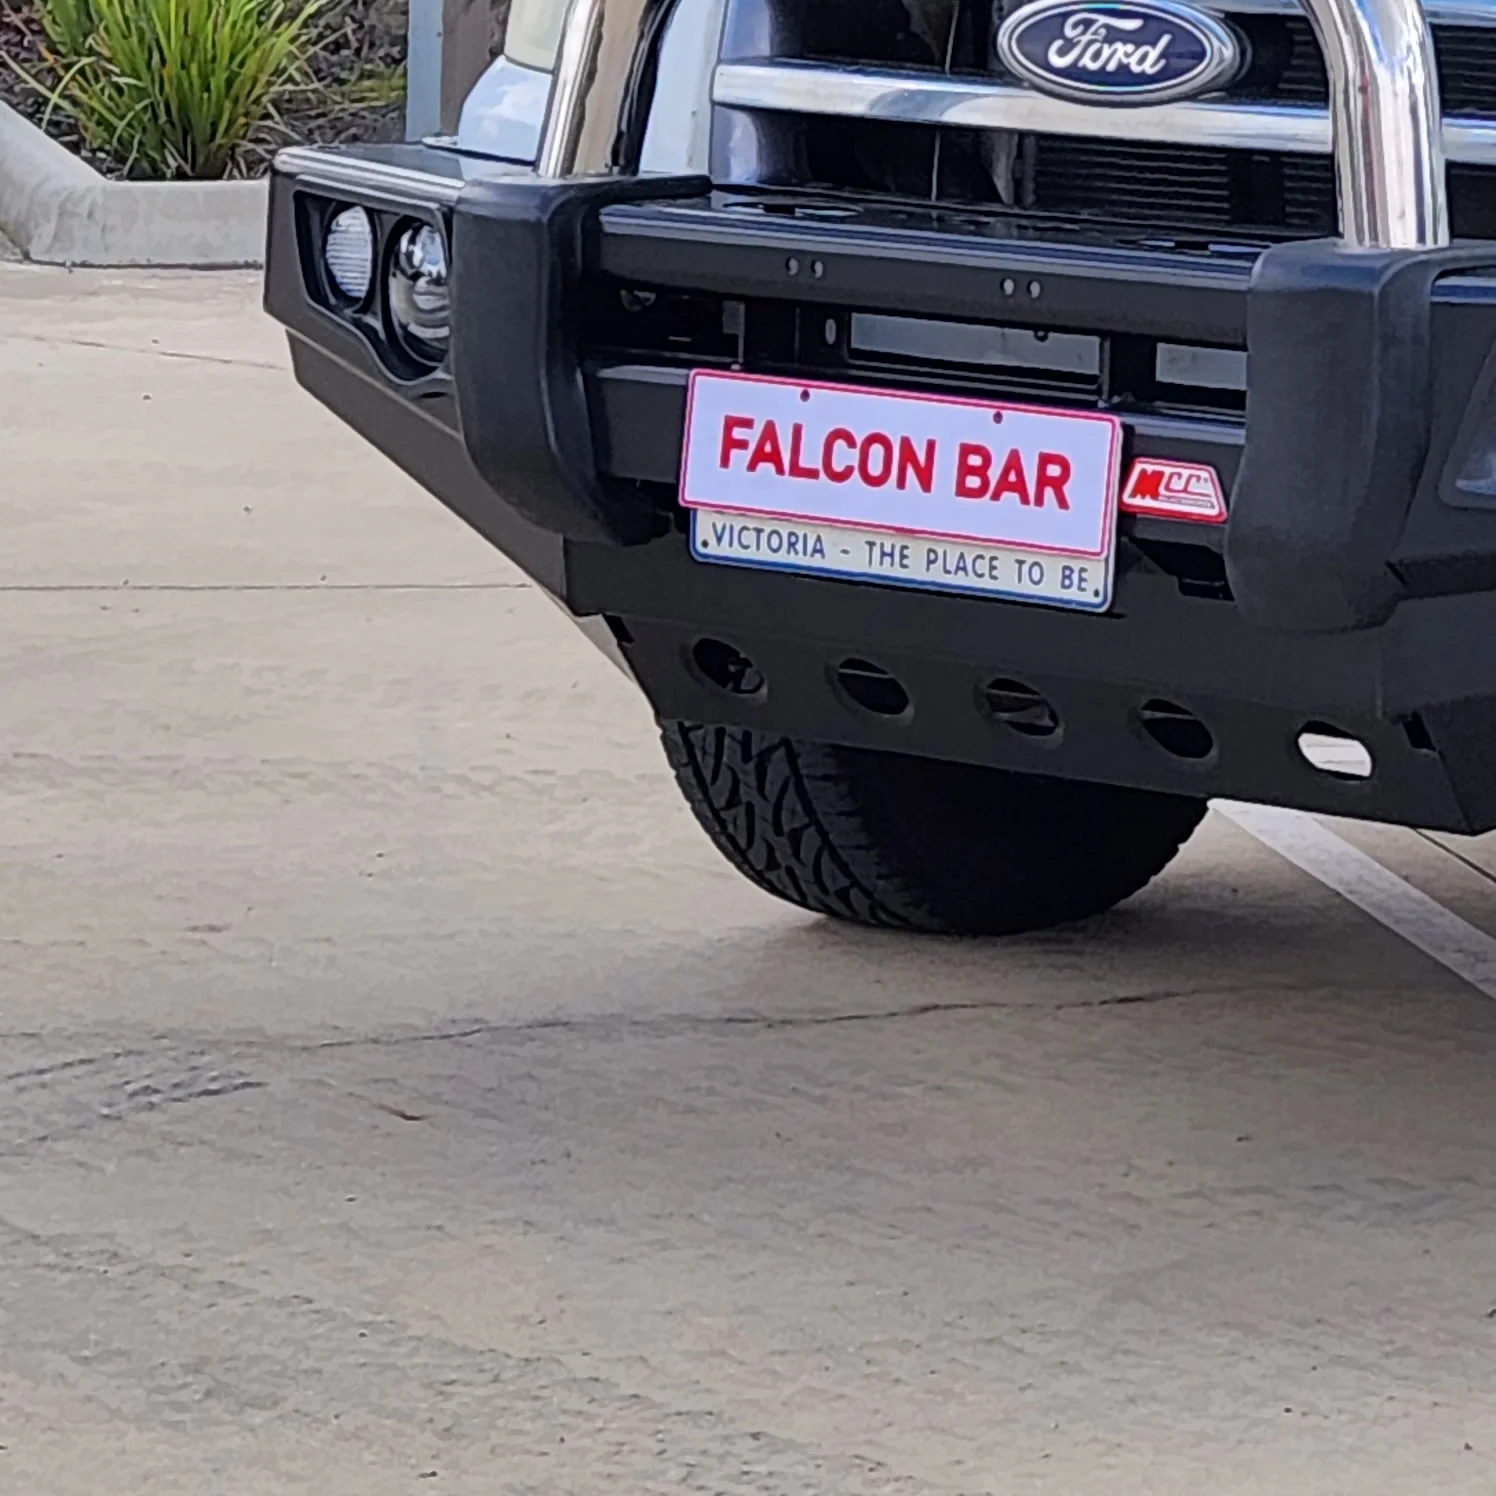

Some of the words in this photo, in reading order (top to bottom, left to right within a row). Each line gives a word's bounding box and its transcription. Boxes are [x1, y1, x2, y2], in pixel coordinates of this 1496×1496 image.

[1048, 12, 1172, 75] Ford
[719, 414, 936, 494] FALCON
[955, 442, 1072, 511] BAR
[711, 521, 826, 561] VICTORIA
[865, 540, 911, 570] THE
[925, 547, 1000, 581] PLACE
[1014, 559, 1045, 587] TO
[1060, 566, 1090, 593] BE
